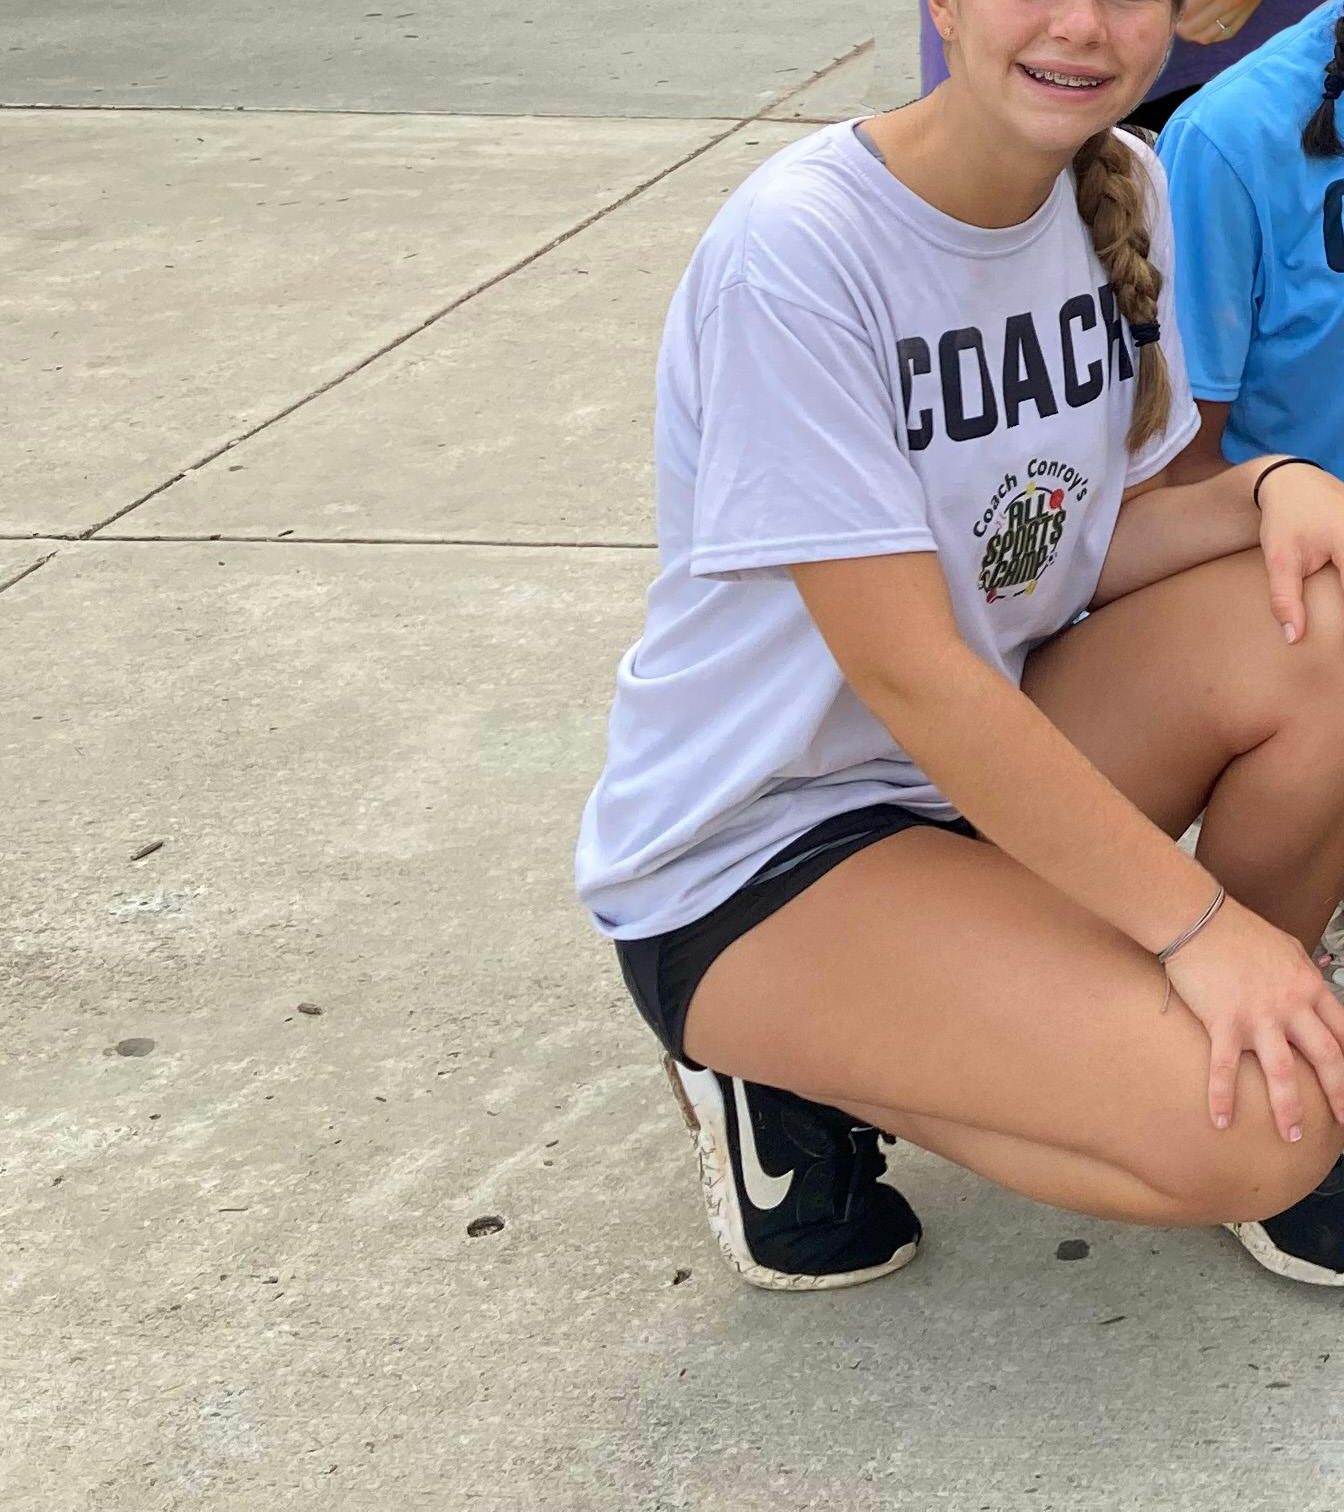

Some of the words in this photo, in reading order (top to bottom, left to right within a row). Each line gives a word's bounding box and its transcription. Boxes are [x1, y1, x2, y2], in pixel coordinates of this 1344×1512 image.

[895, 282, 1134, 452] COACH
[972, 473, 1018, 538] Coach
[1027, 458, 1089, 502] Conroy's
[1007, 492, 1049, 529] ALL
[981, 508, 1067, 568] SPORTS
[988, 544, 1049, 589] CAMP
